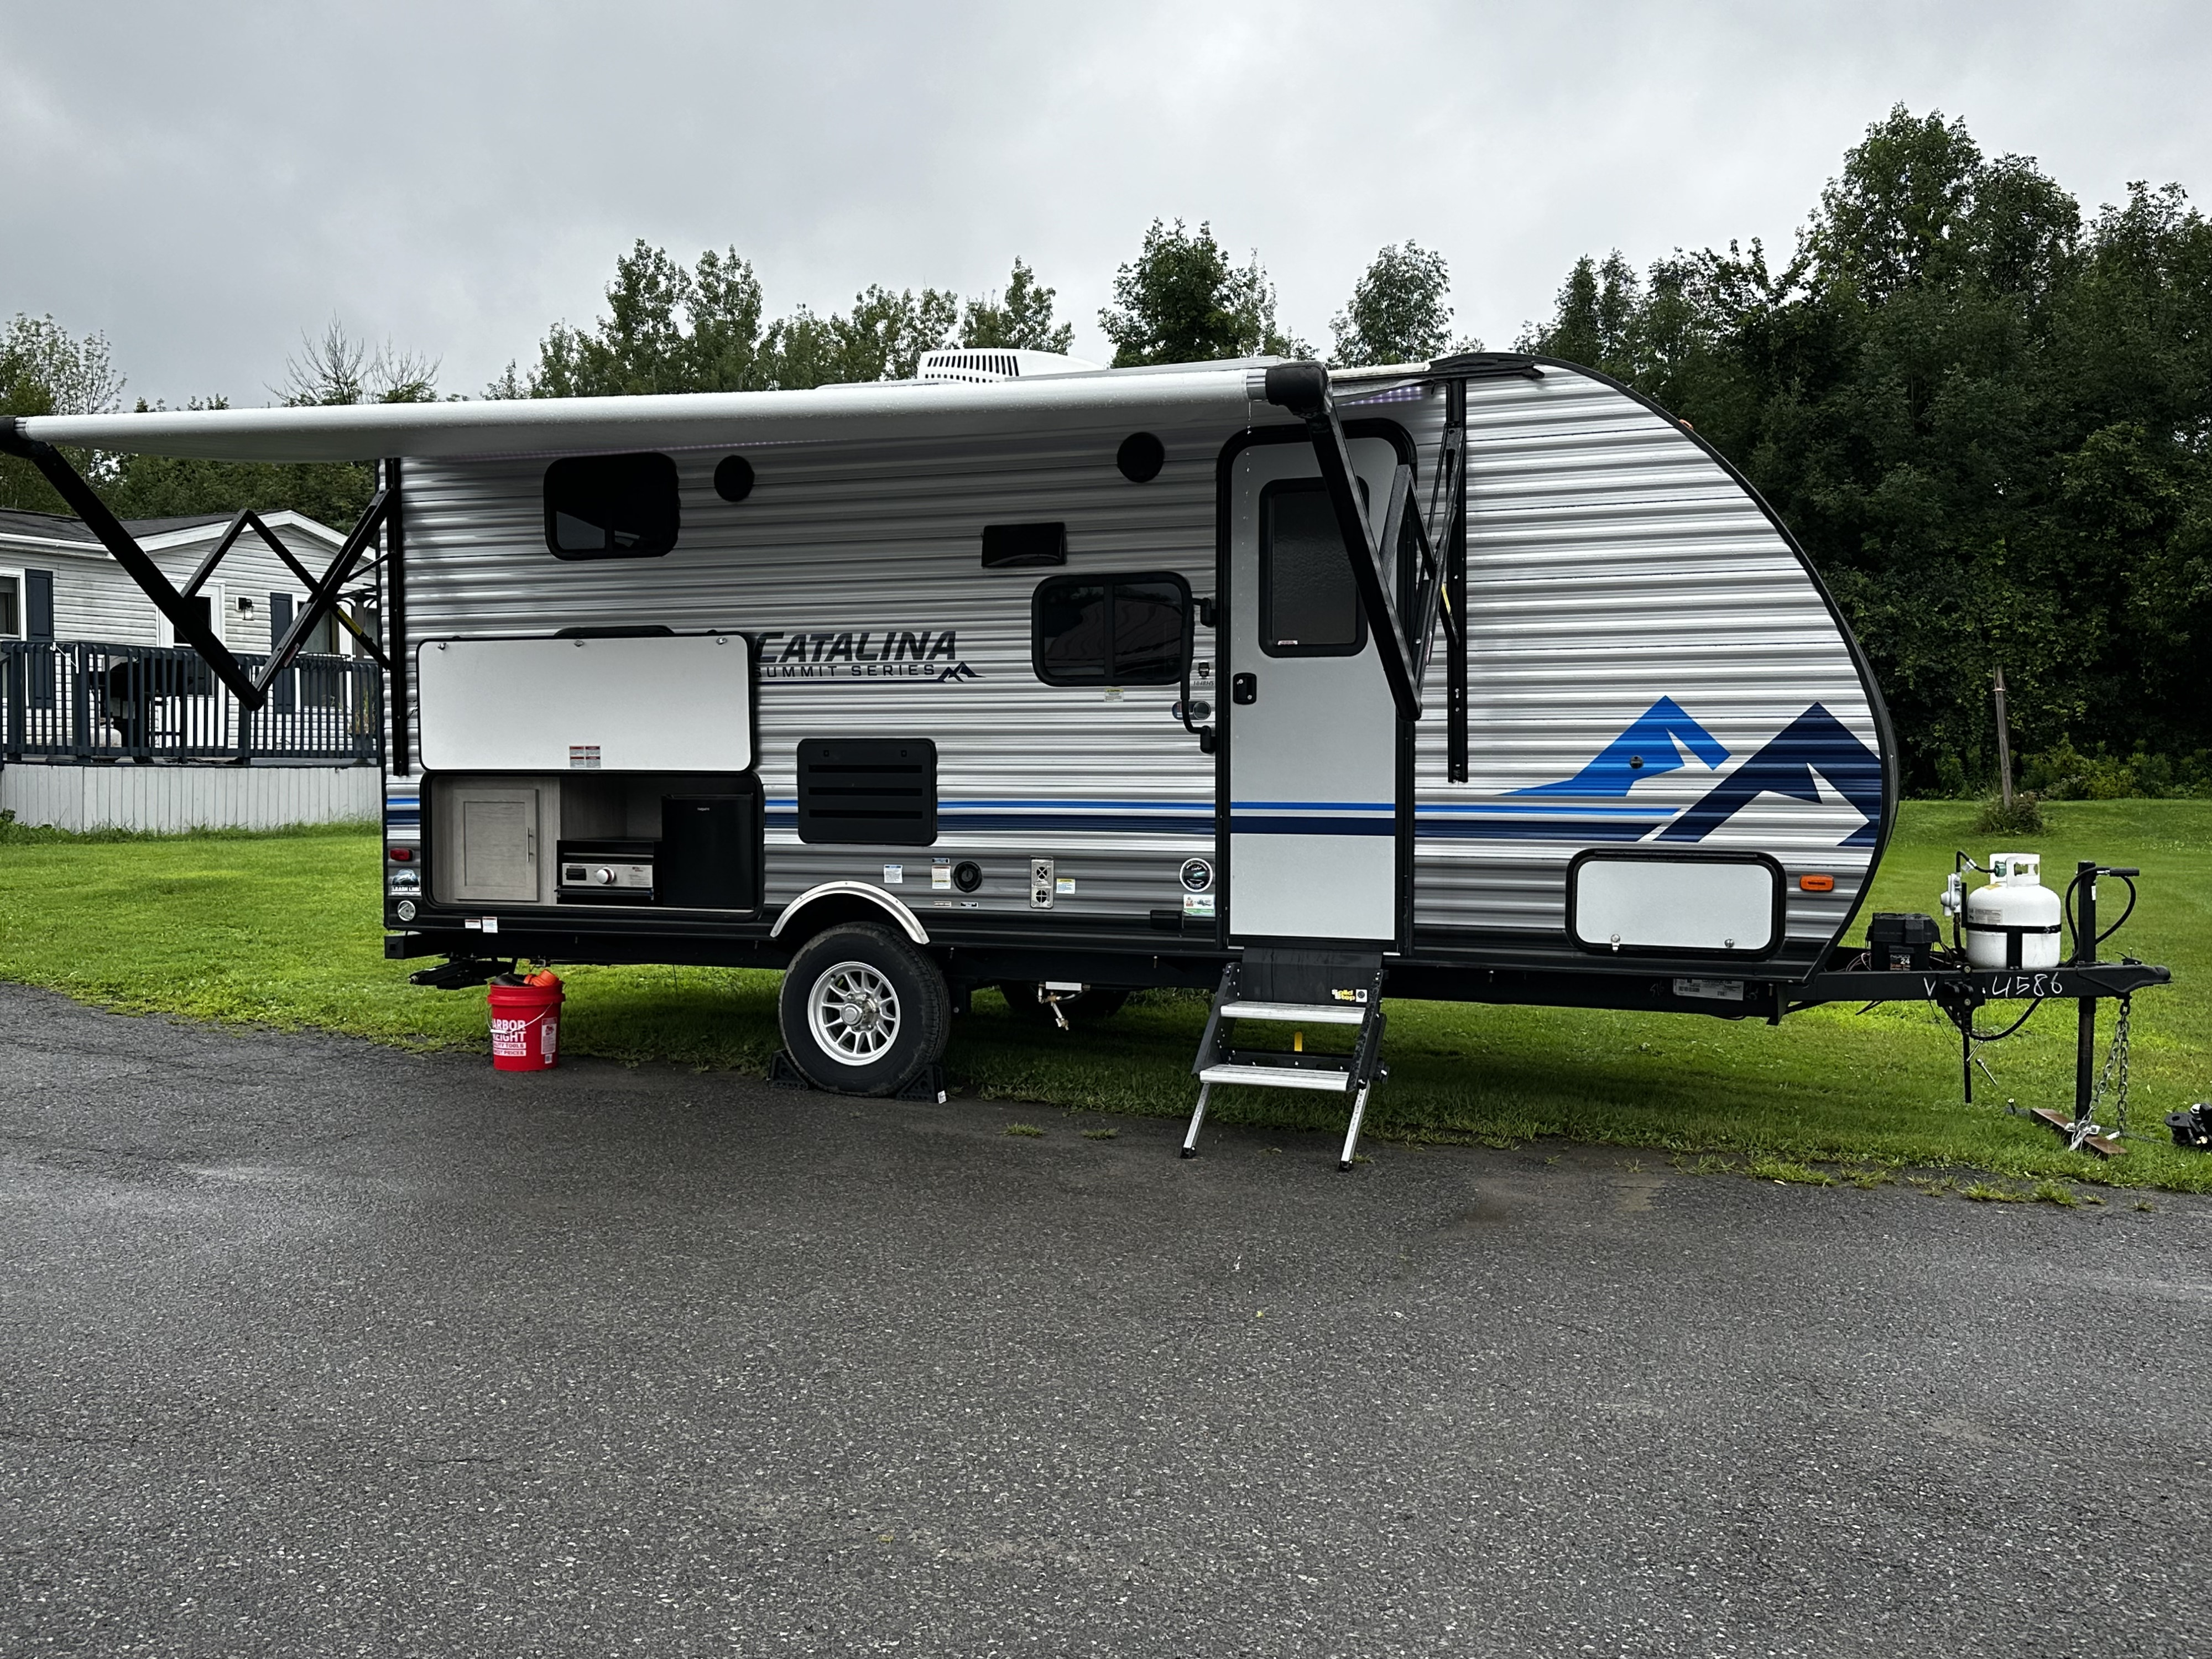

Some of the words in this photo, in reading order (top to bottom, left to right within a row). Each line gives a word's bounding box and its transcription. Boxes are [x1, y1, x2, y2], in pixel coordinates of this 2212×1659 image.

[753, 631, 956, 663] CATALINA
[753, 665, 838, 678] SUMMIT
[851, 664, 935, 677] SERIES
[1992, 972, 2063, 998] 4586
